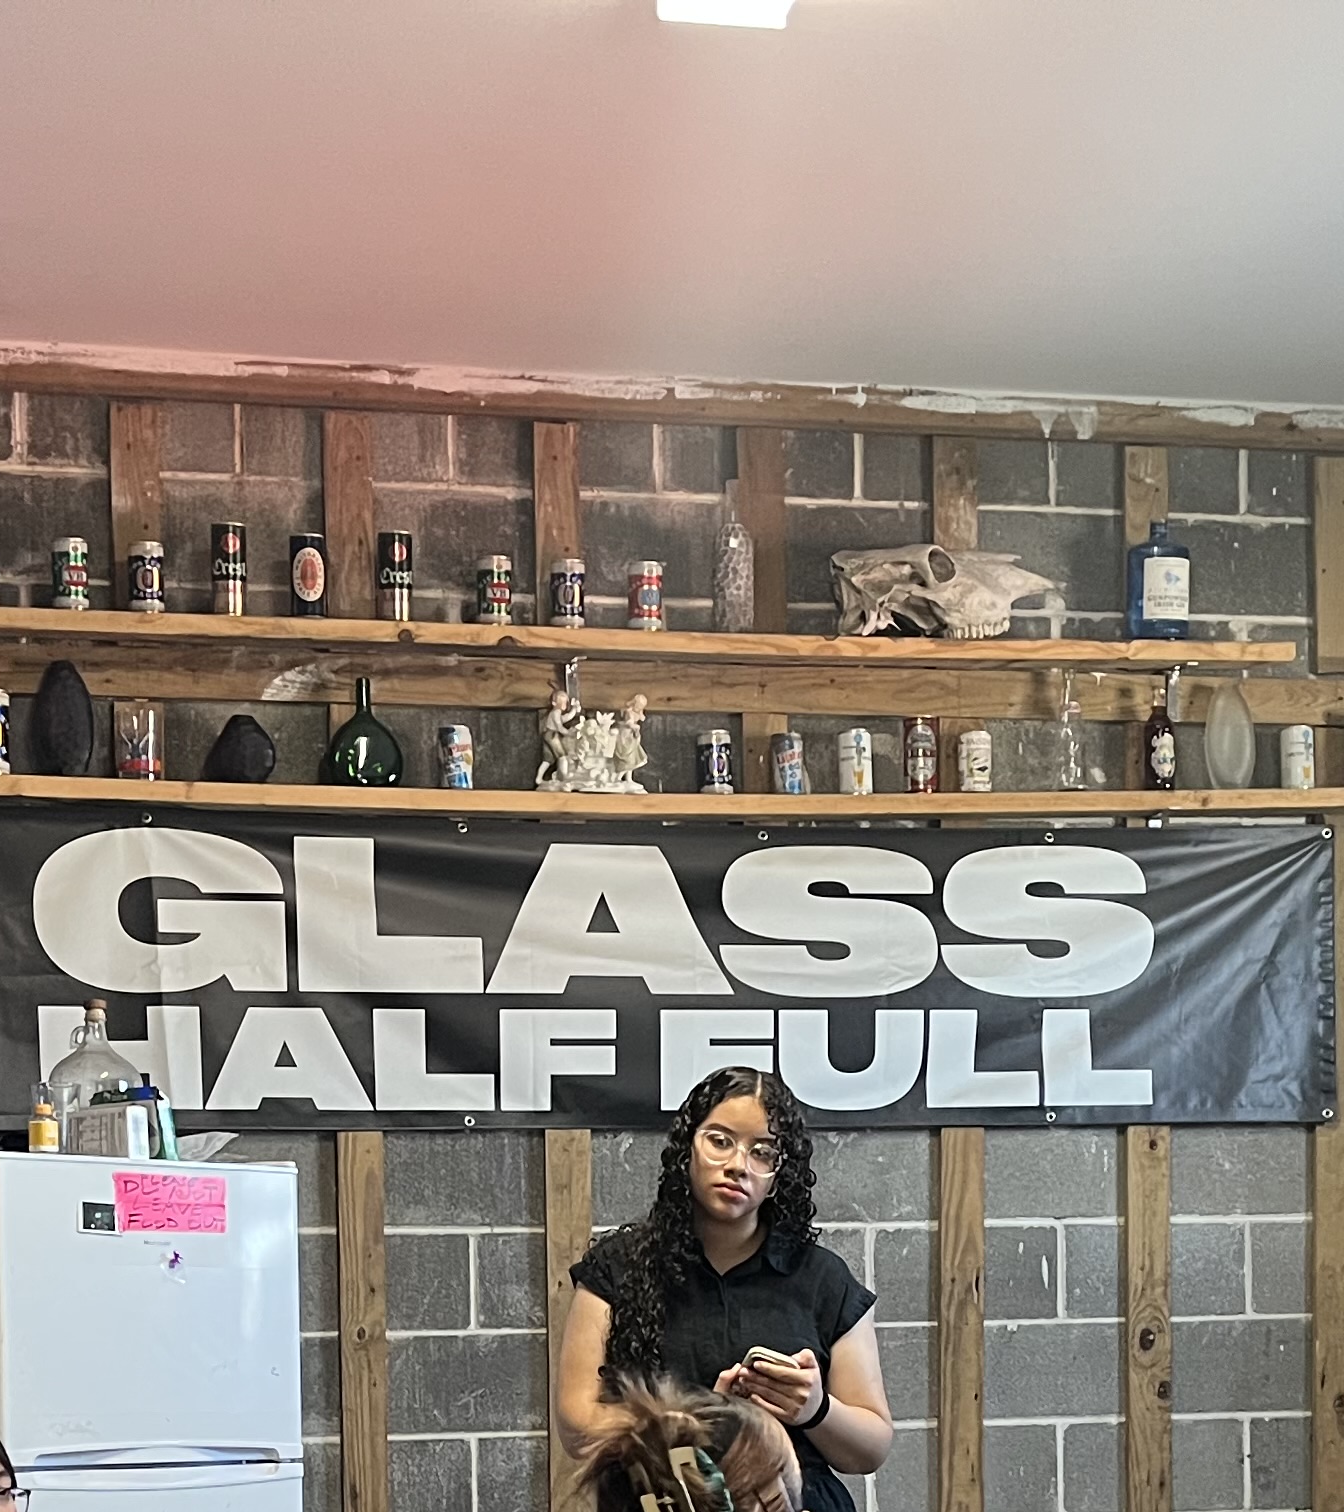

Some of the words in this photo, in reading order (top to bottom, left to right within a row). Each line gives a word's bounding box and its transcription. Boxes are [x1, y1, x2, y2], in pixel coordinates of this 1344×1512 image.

[32, 826, 1155, 998] GLASS
[37, 1005, 617, 1112] HALF
[660, 1008, 1154, 1107] FULL
